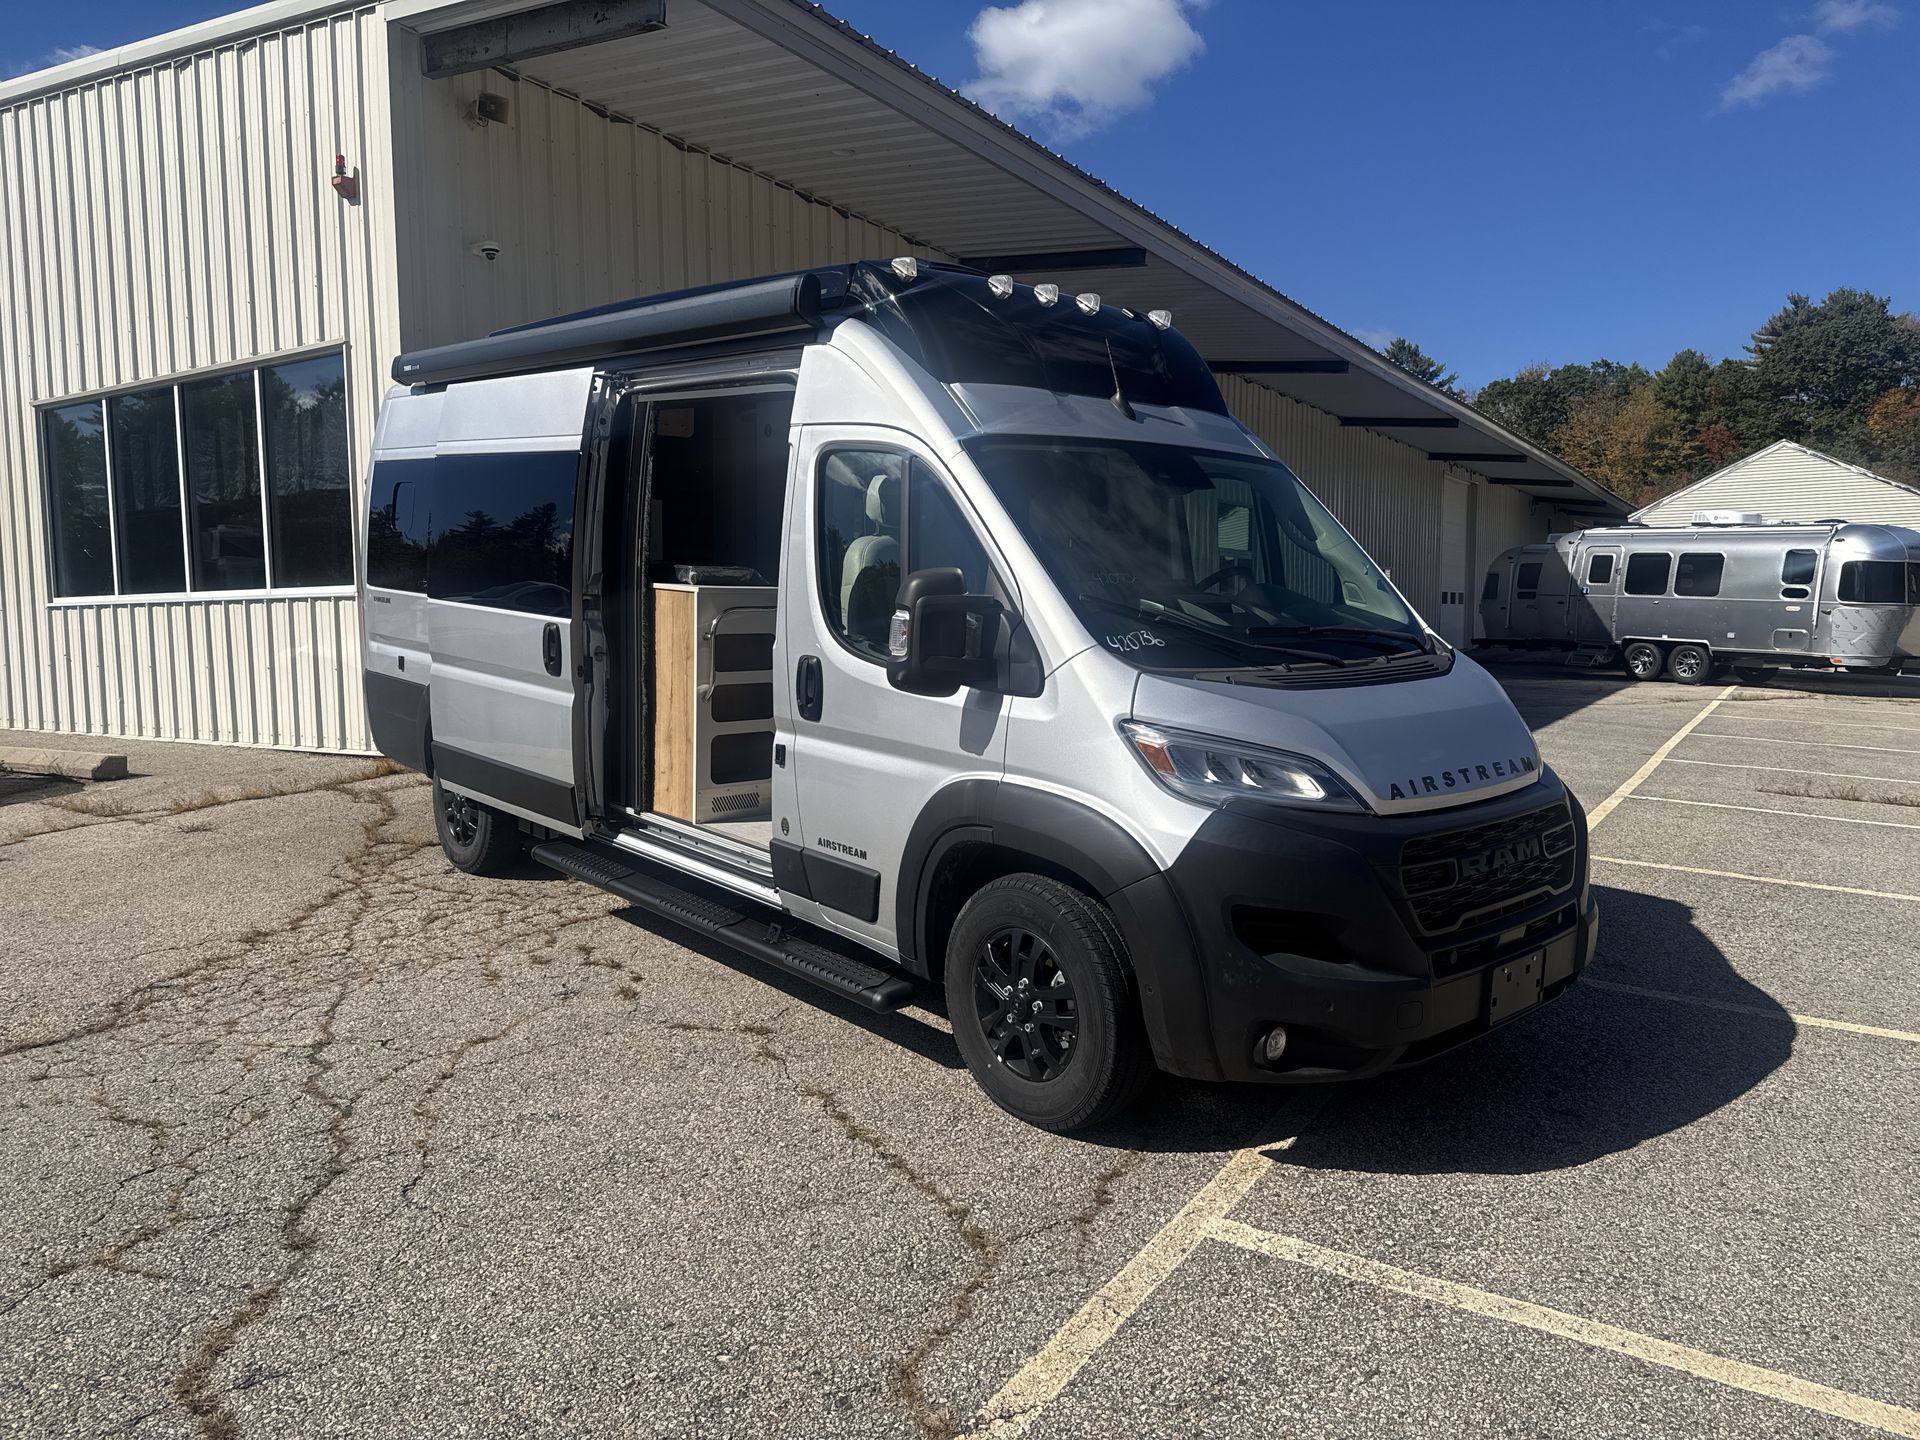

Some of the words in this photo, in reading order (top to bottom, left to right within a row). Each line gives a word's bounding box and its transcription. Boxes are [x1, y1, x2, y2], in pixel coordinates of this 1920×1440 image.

[1106, 630, 1166, 651] 420736
[1390, 757, 1535, 800] AIRSTREAM
[817, 837, 867, 860] AIRSTREAM
[1462, 837, 1540, 877] RAM
